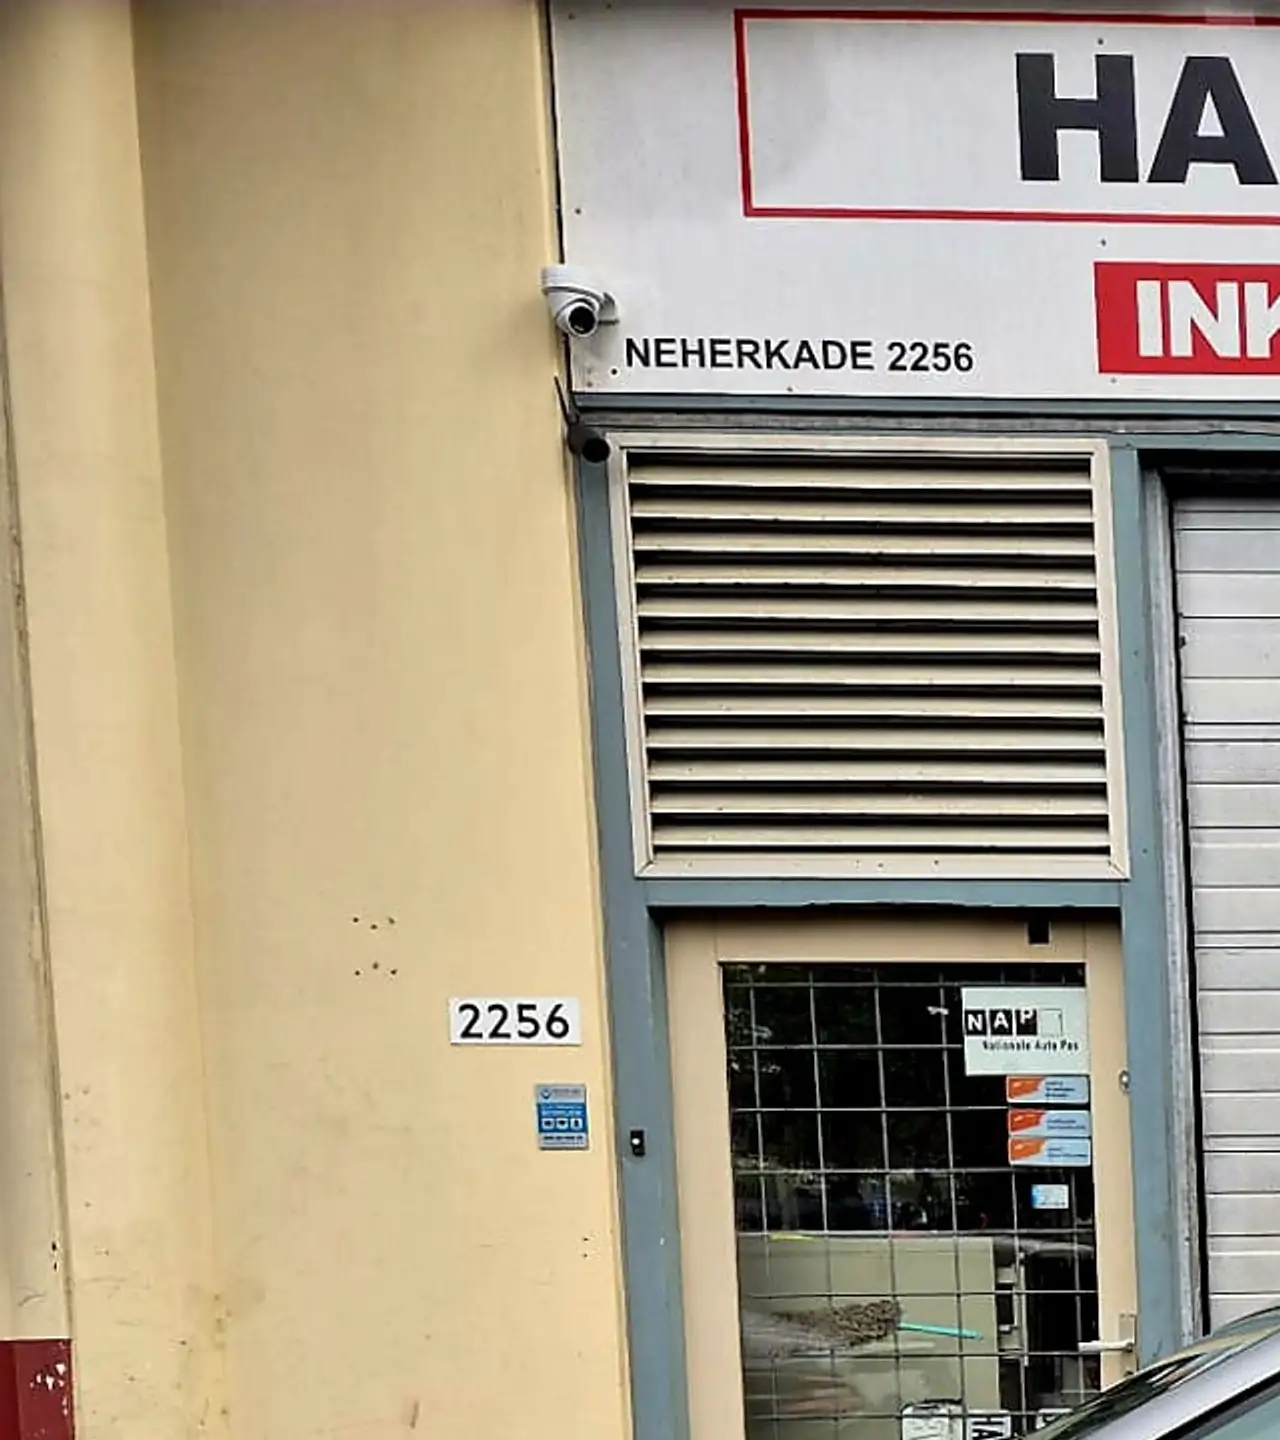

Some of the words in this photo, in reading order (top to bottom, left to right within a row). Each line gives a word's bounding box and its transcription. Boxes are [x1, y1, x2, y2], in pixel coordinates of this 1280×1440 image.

[625, 337, 876, 371] NEHERKADE
[887, 341, 974, 373] 2256
[458, 1003, 571, 1039] 2256
[966, 1009, 1037, 1033] NAP
[982, 1040, 1031, 1051] Nationale
[1034, 1039, 1057, 1051] Auto
[1060, 1039, 1079, 1051] Pas
